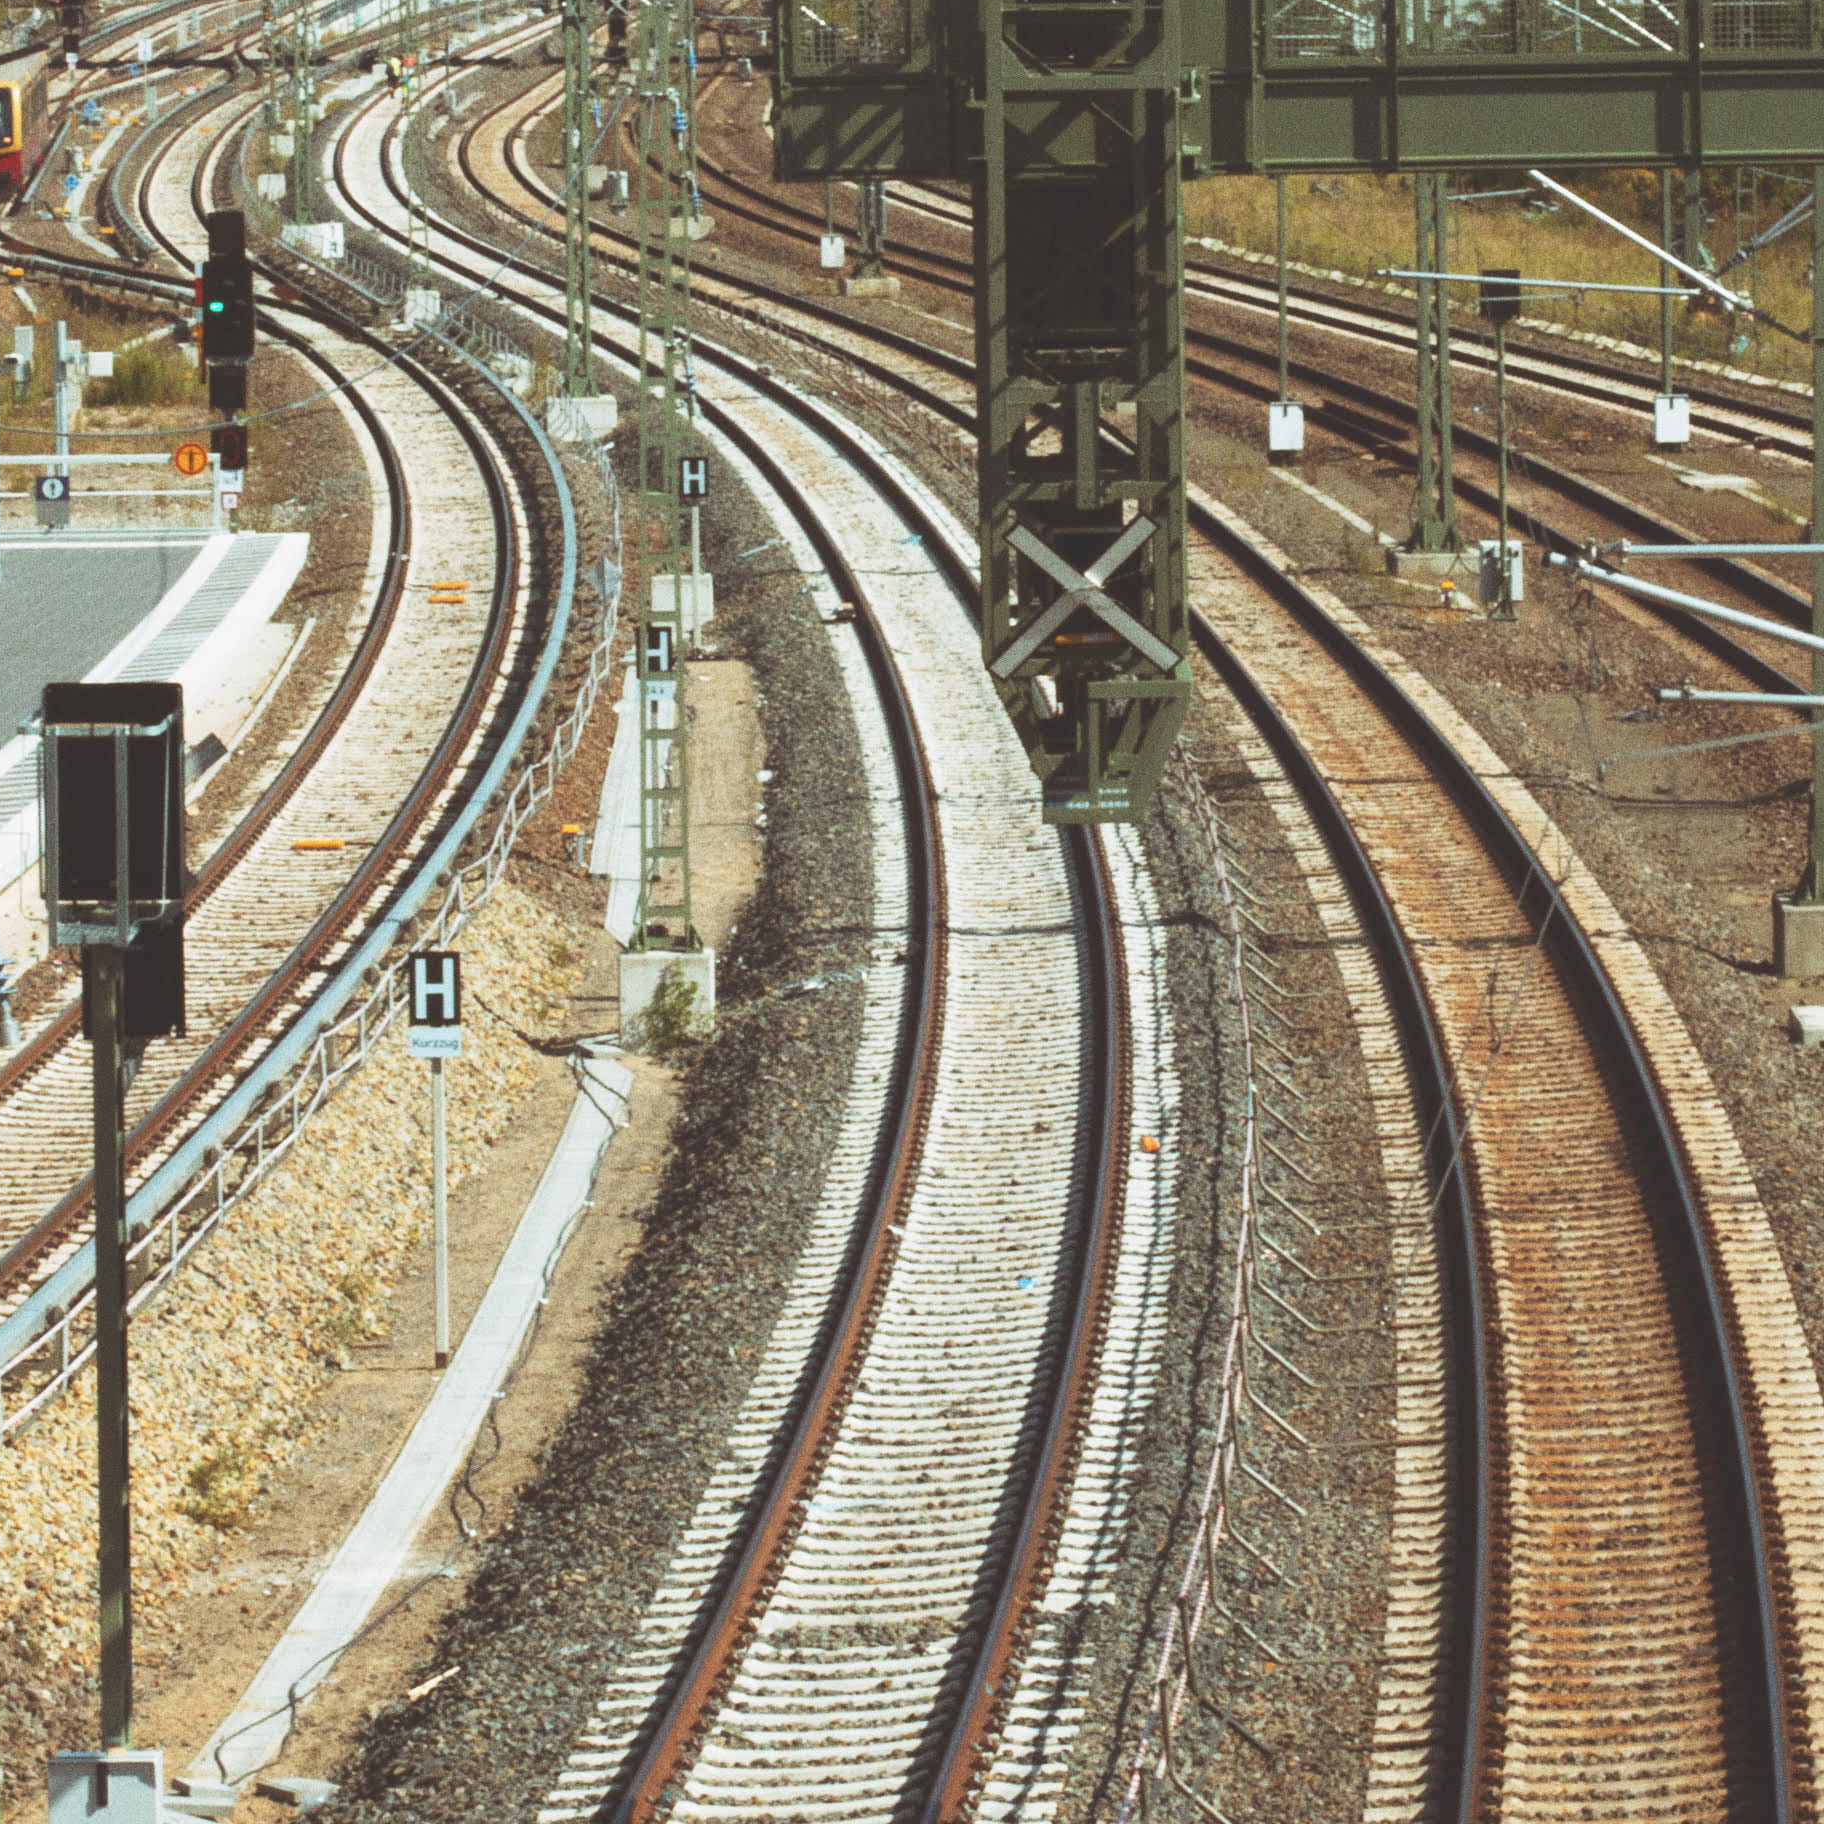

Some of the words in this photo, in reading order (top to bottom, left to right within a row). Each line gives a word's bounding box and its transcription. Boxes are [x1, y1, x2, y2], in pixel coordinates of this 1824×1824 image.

[682, 460, 706, 495] H
[415, 958, 455, 1019] H
[412, 1038, 458, 1051] Kurzzug
